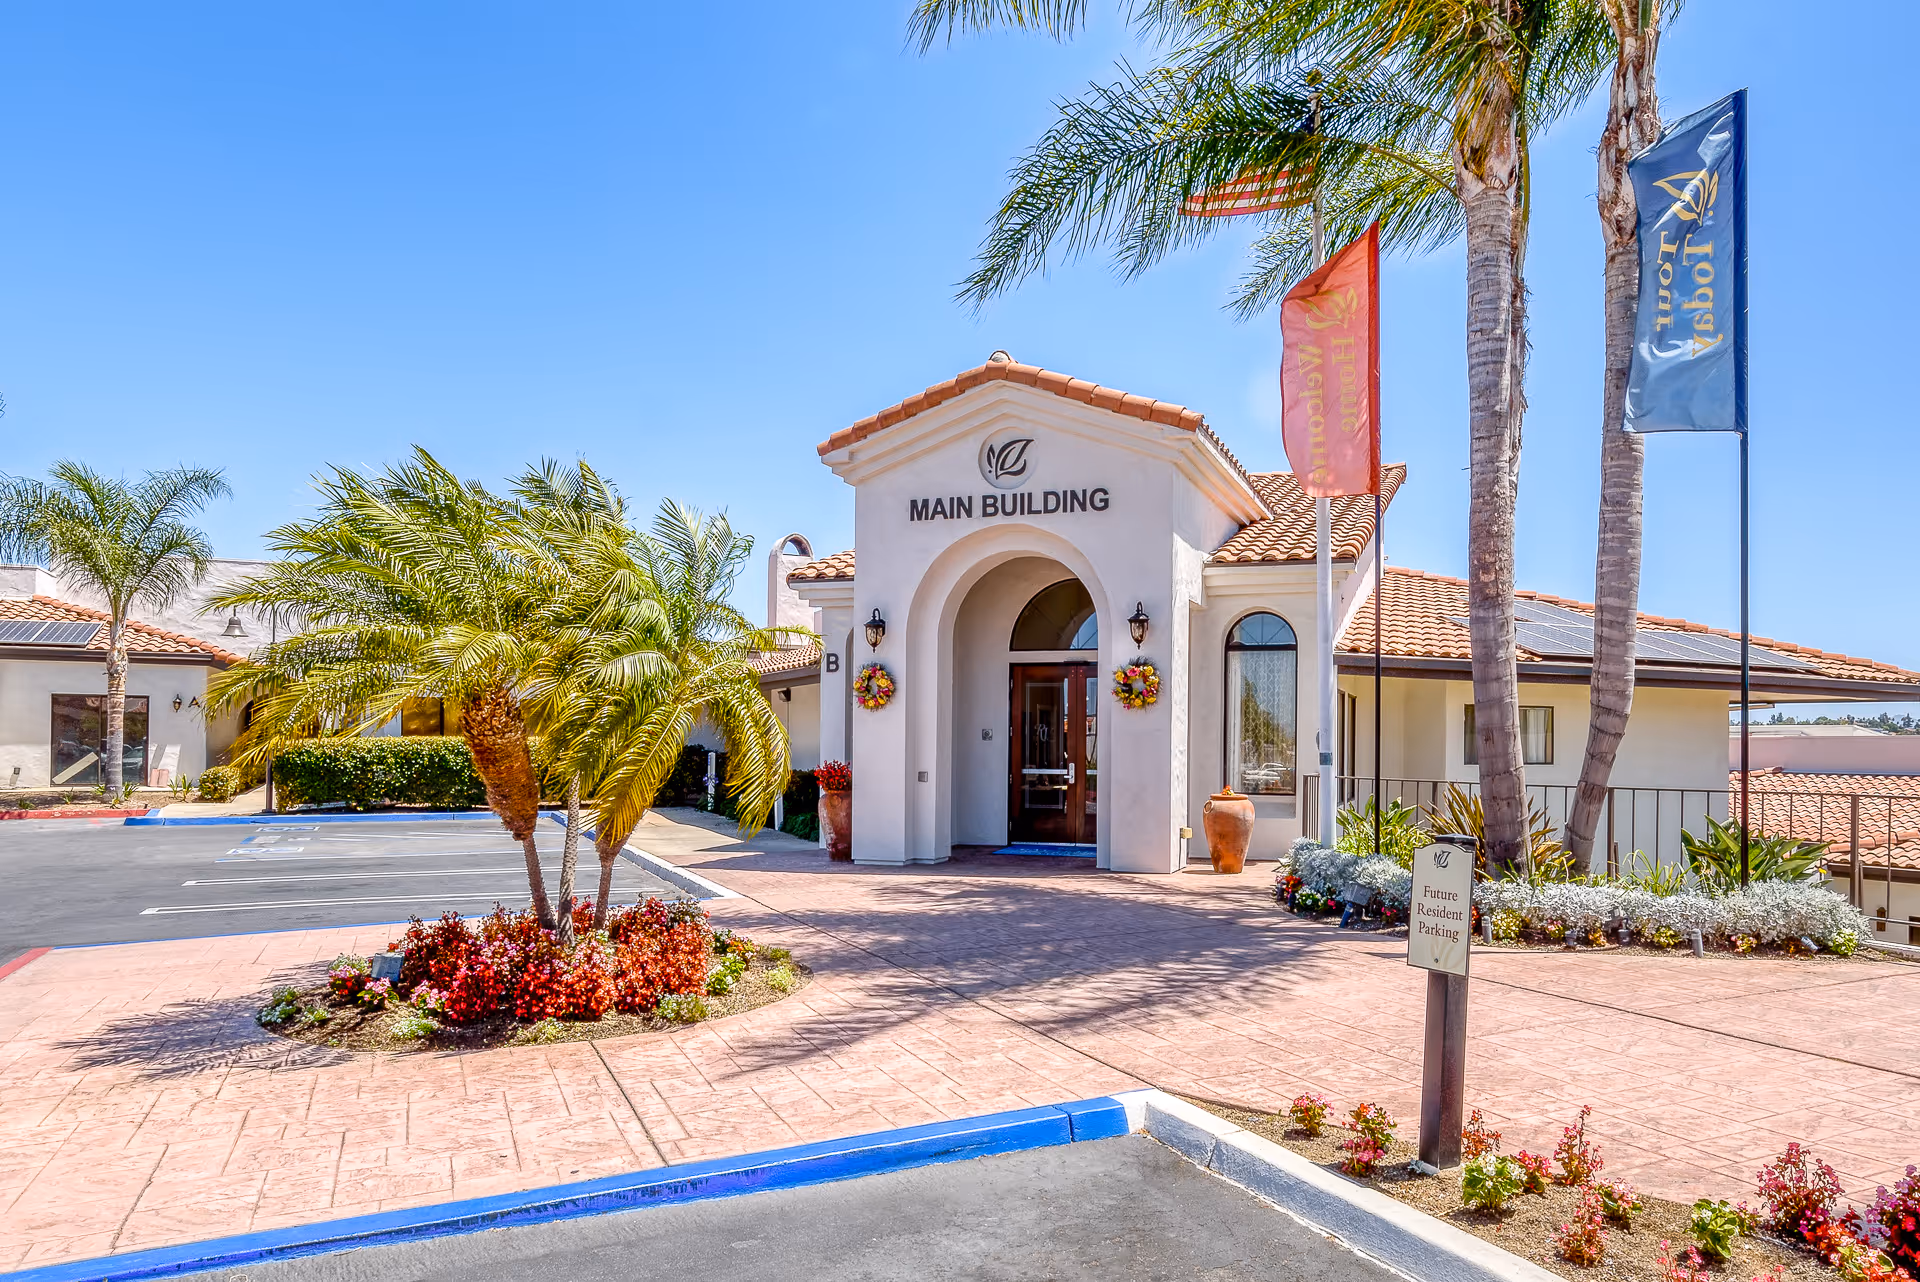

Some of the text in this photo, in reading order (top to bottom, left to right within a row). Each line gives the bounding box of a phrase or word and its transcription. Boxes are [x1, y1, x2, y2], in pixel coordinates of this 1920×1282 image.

[909, 487, 1110, 522] MAIN BUILDING
[826, 652, 840, 673] B
[1423, 885, 1458, 902] Future
[1416, 902, 1464, 921] Resident
[1418, 920, 1459, 943] Parking
